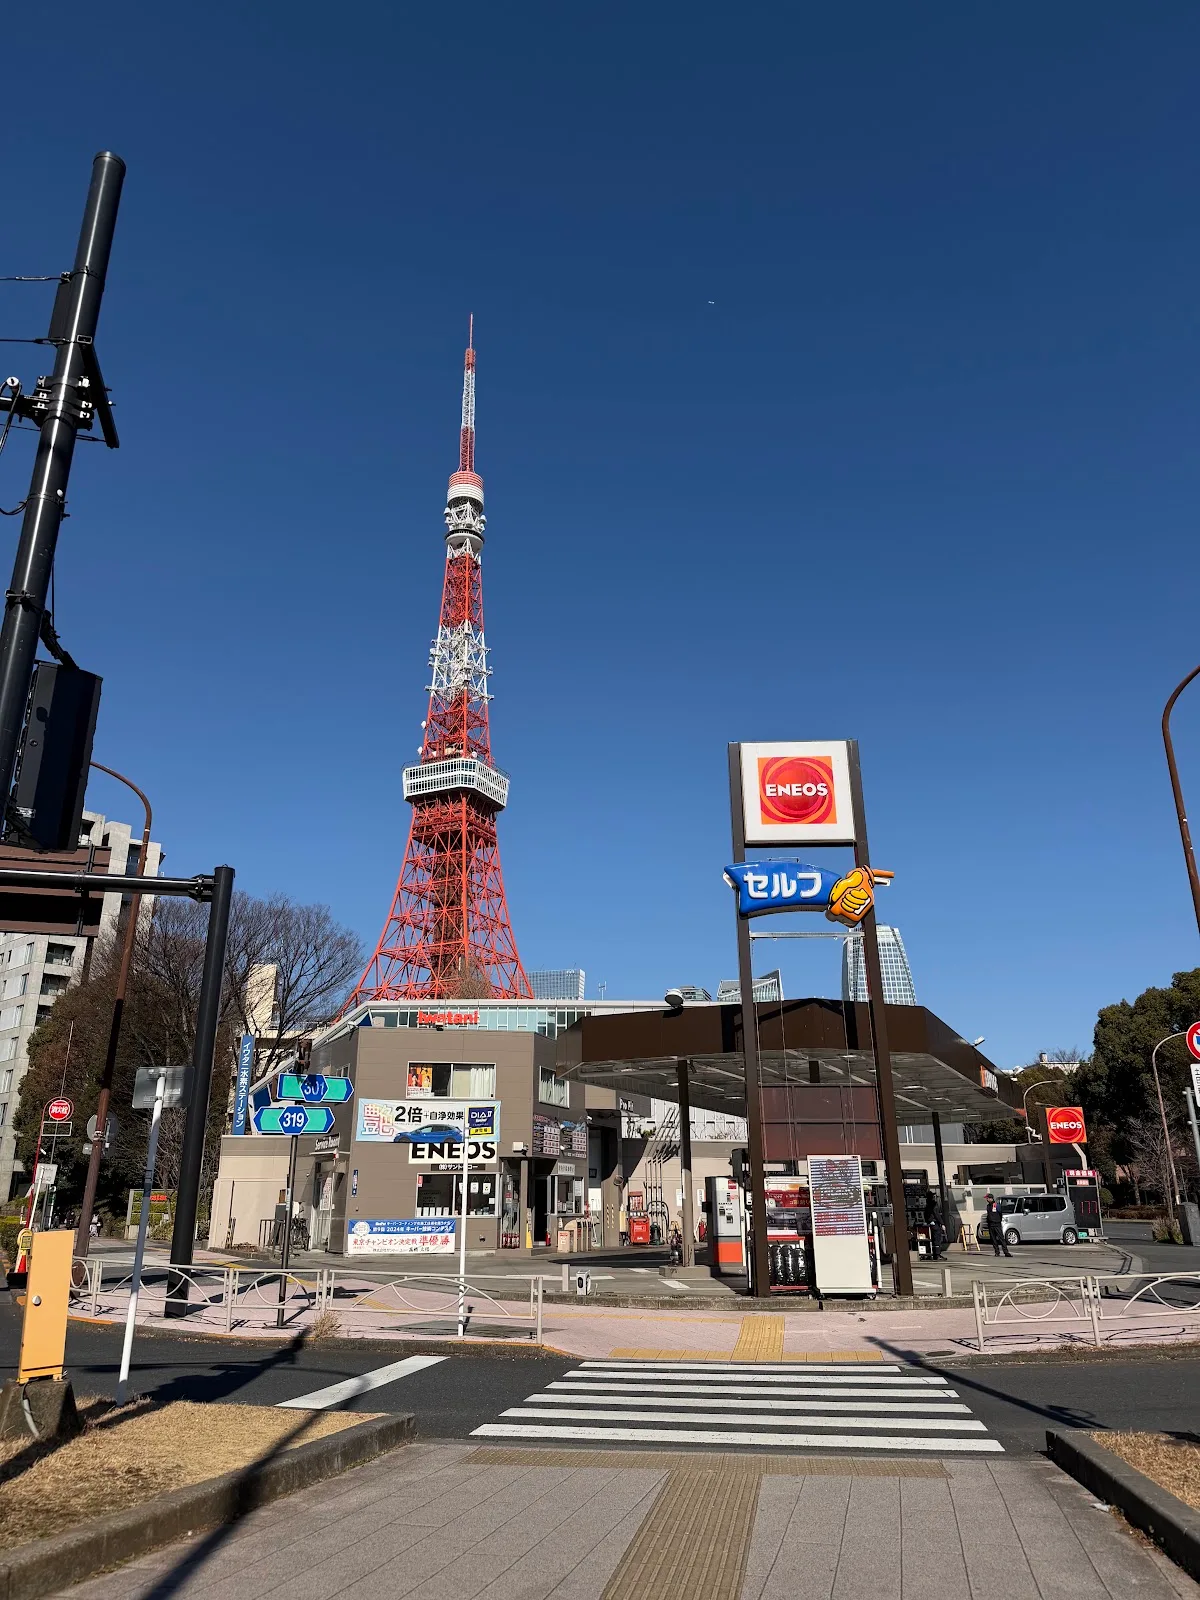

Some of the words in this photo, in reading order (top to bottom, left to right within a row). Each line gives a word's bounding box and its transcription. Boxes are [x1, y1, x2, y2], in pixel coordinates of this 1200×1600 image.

[765, 782, 829, 797] ENEOS
[743, 871, 822, 899] セルフ
[236, 1042, 251, 1127] イワタニ水素ステーション
[303, 1080, 325, 1096] 301
[282, 1112, 305, 1128] 319
[361, 1104, 394, 1136] 艶
[394, 1105, 423, 1123] 2倍
[1050, 1121, 1083, 1130] ENEOS
[411, 1142, 496, 1159] ENEOS
[418, 1234, 450, 1246] 準優勝
